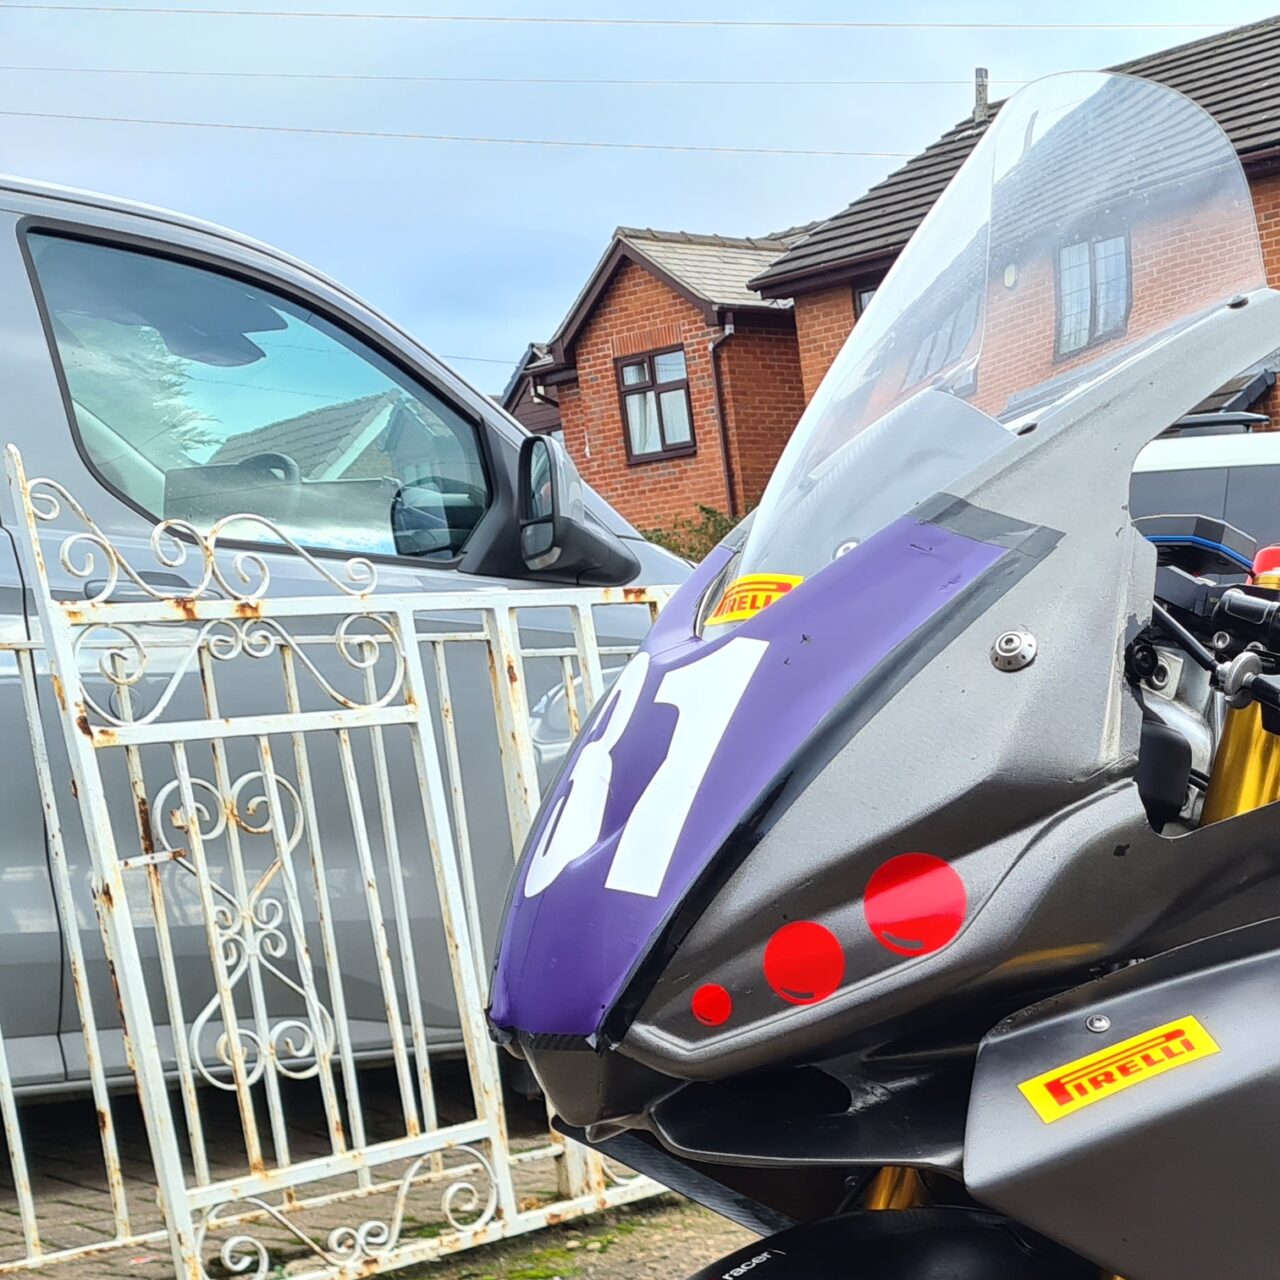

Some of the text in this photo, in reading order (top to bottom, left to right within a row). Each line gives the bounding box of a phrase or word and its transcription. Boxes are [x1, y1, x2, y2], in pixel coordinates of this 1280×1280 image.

[524, 636, 771, 898] 31
[1043, 1028, 1196, 1107] PIRELLI
[722, 1251, 772, 1280] racer
